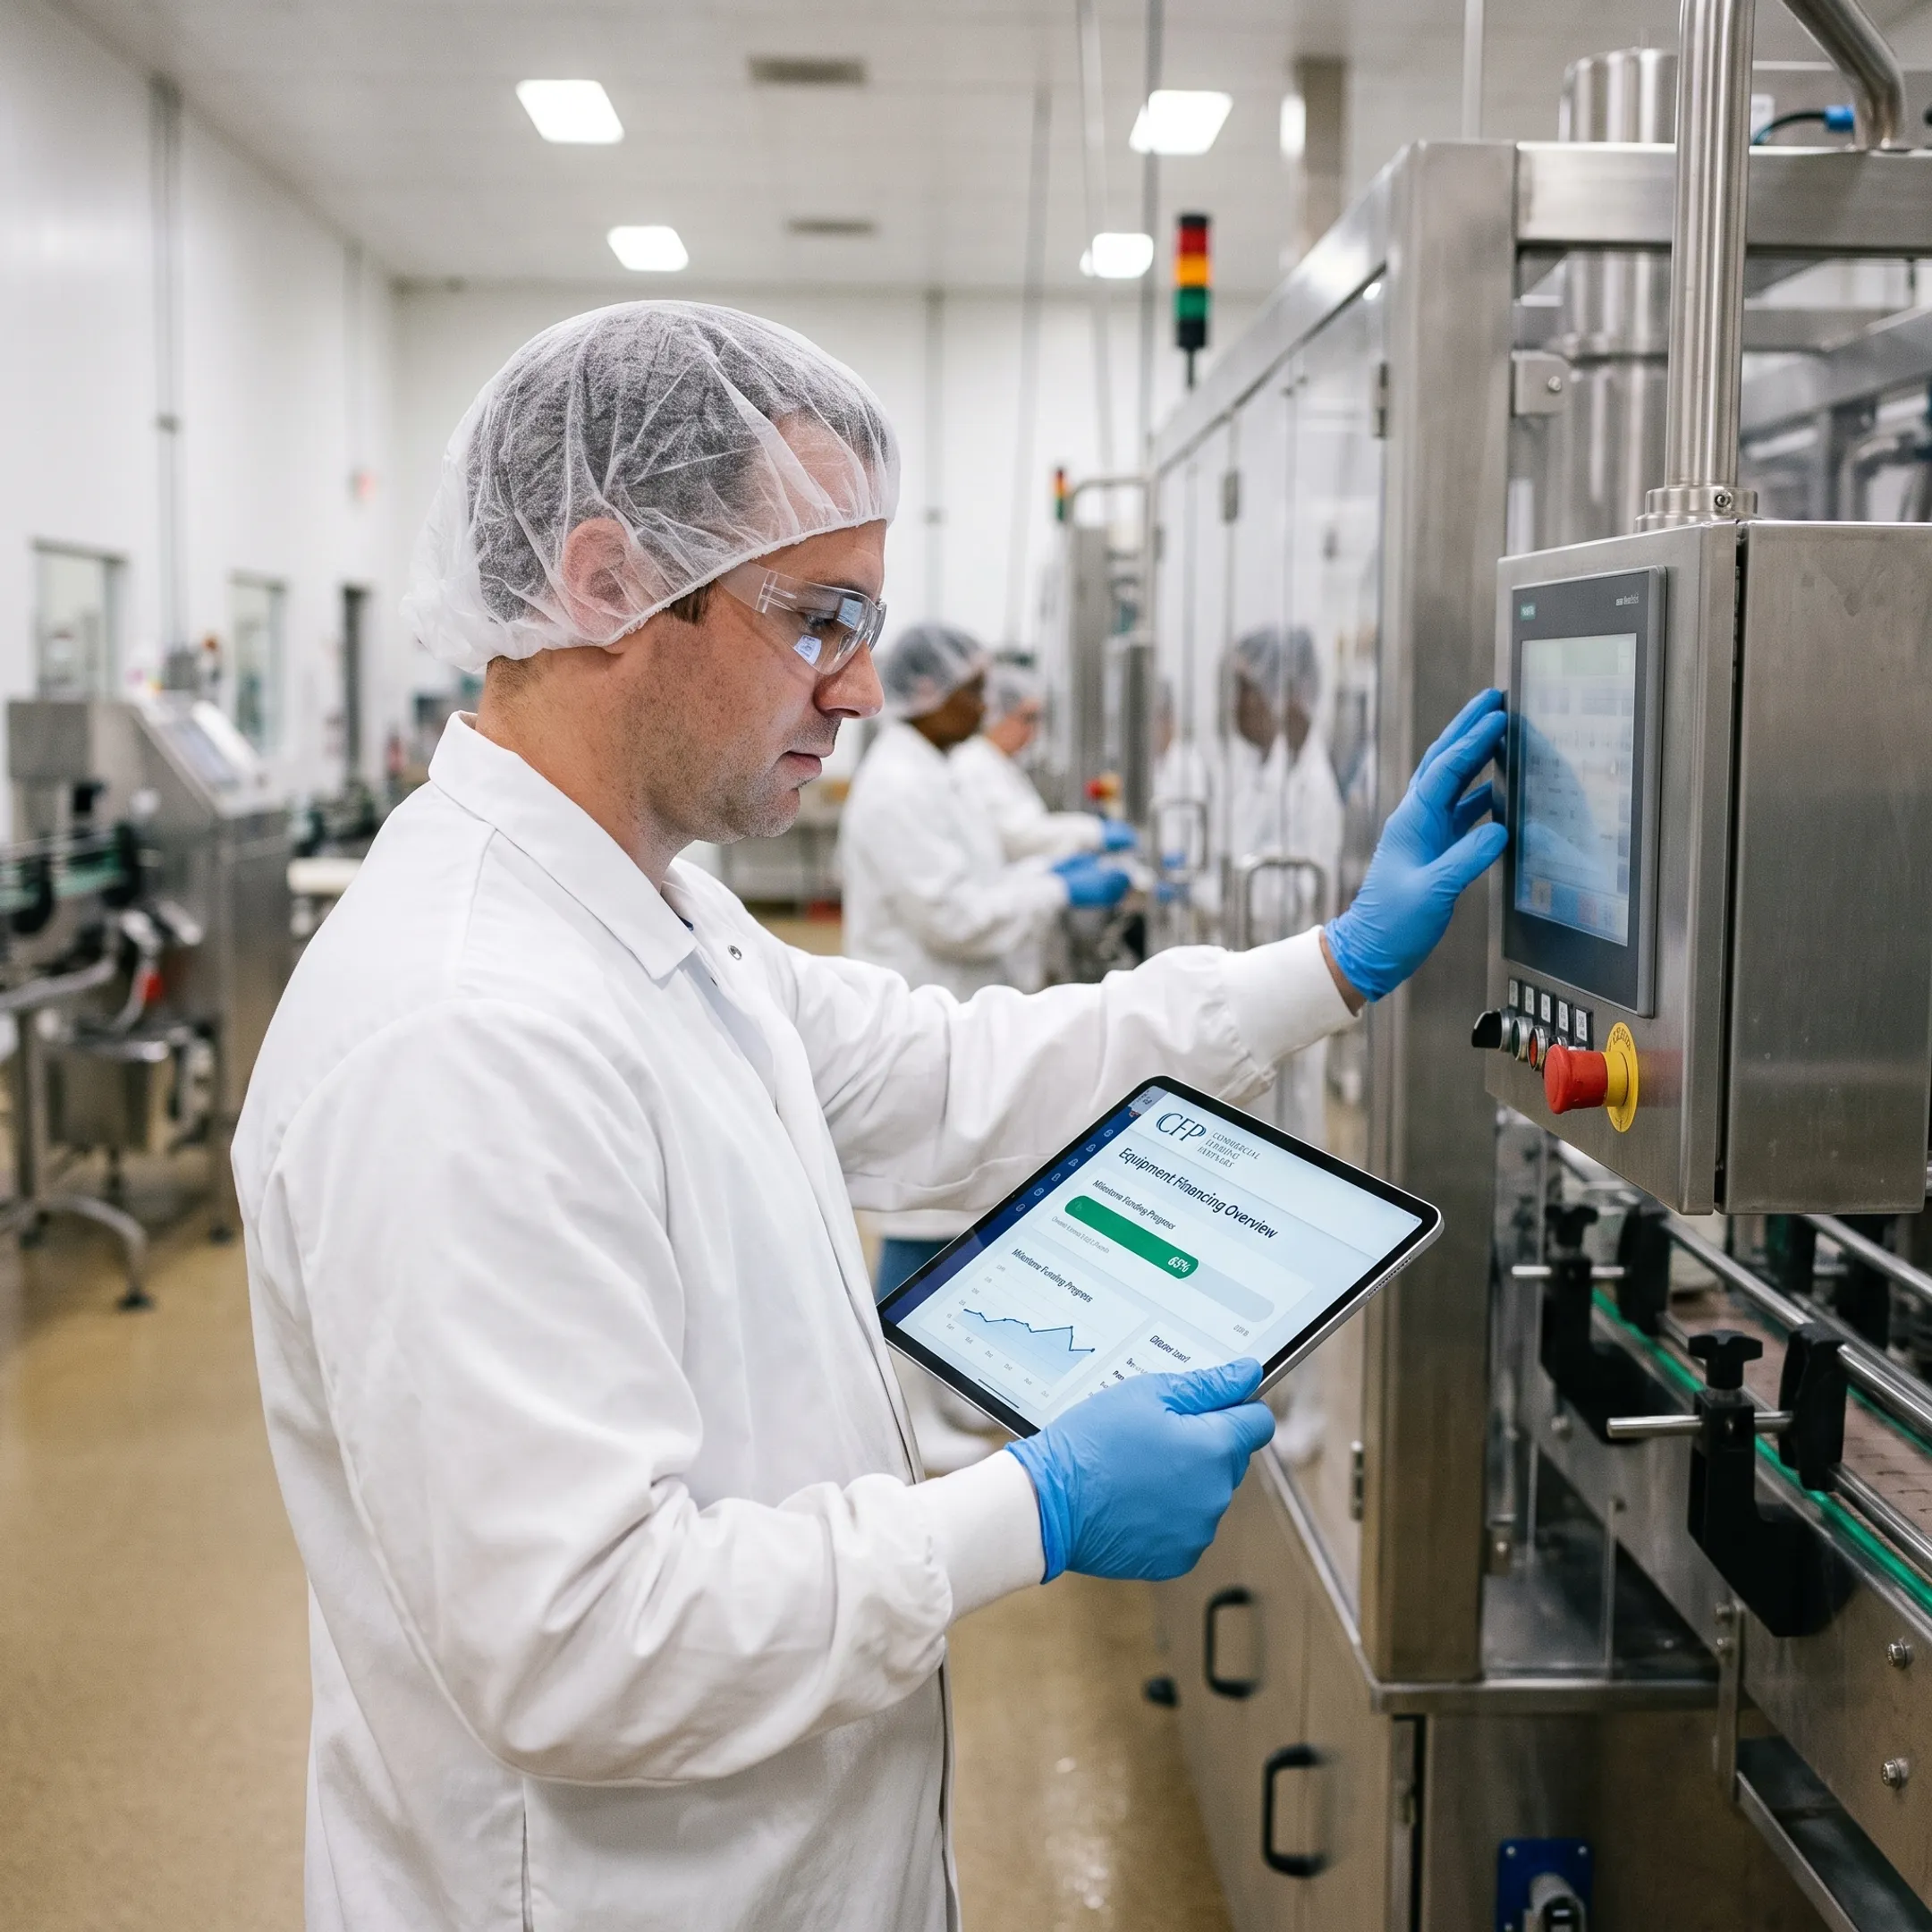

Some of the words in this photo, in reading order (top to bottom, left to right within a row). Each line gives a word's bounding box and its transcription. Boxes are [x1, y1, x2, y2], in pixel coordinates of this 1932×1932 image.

[1156, 1112, 1207, 1141] CFP
[1118, 1148, 1176, 1185] Equipment
[1174, 1176, 1226, 1214] Financing
[1224, 1205, 1278, 1240] Overview
[1167, 1256, 1191, 1273] 65%
